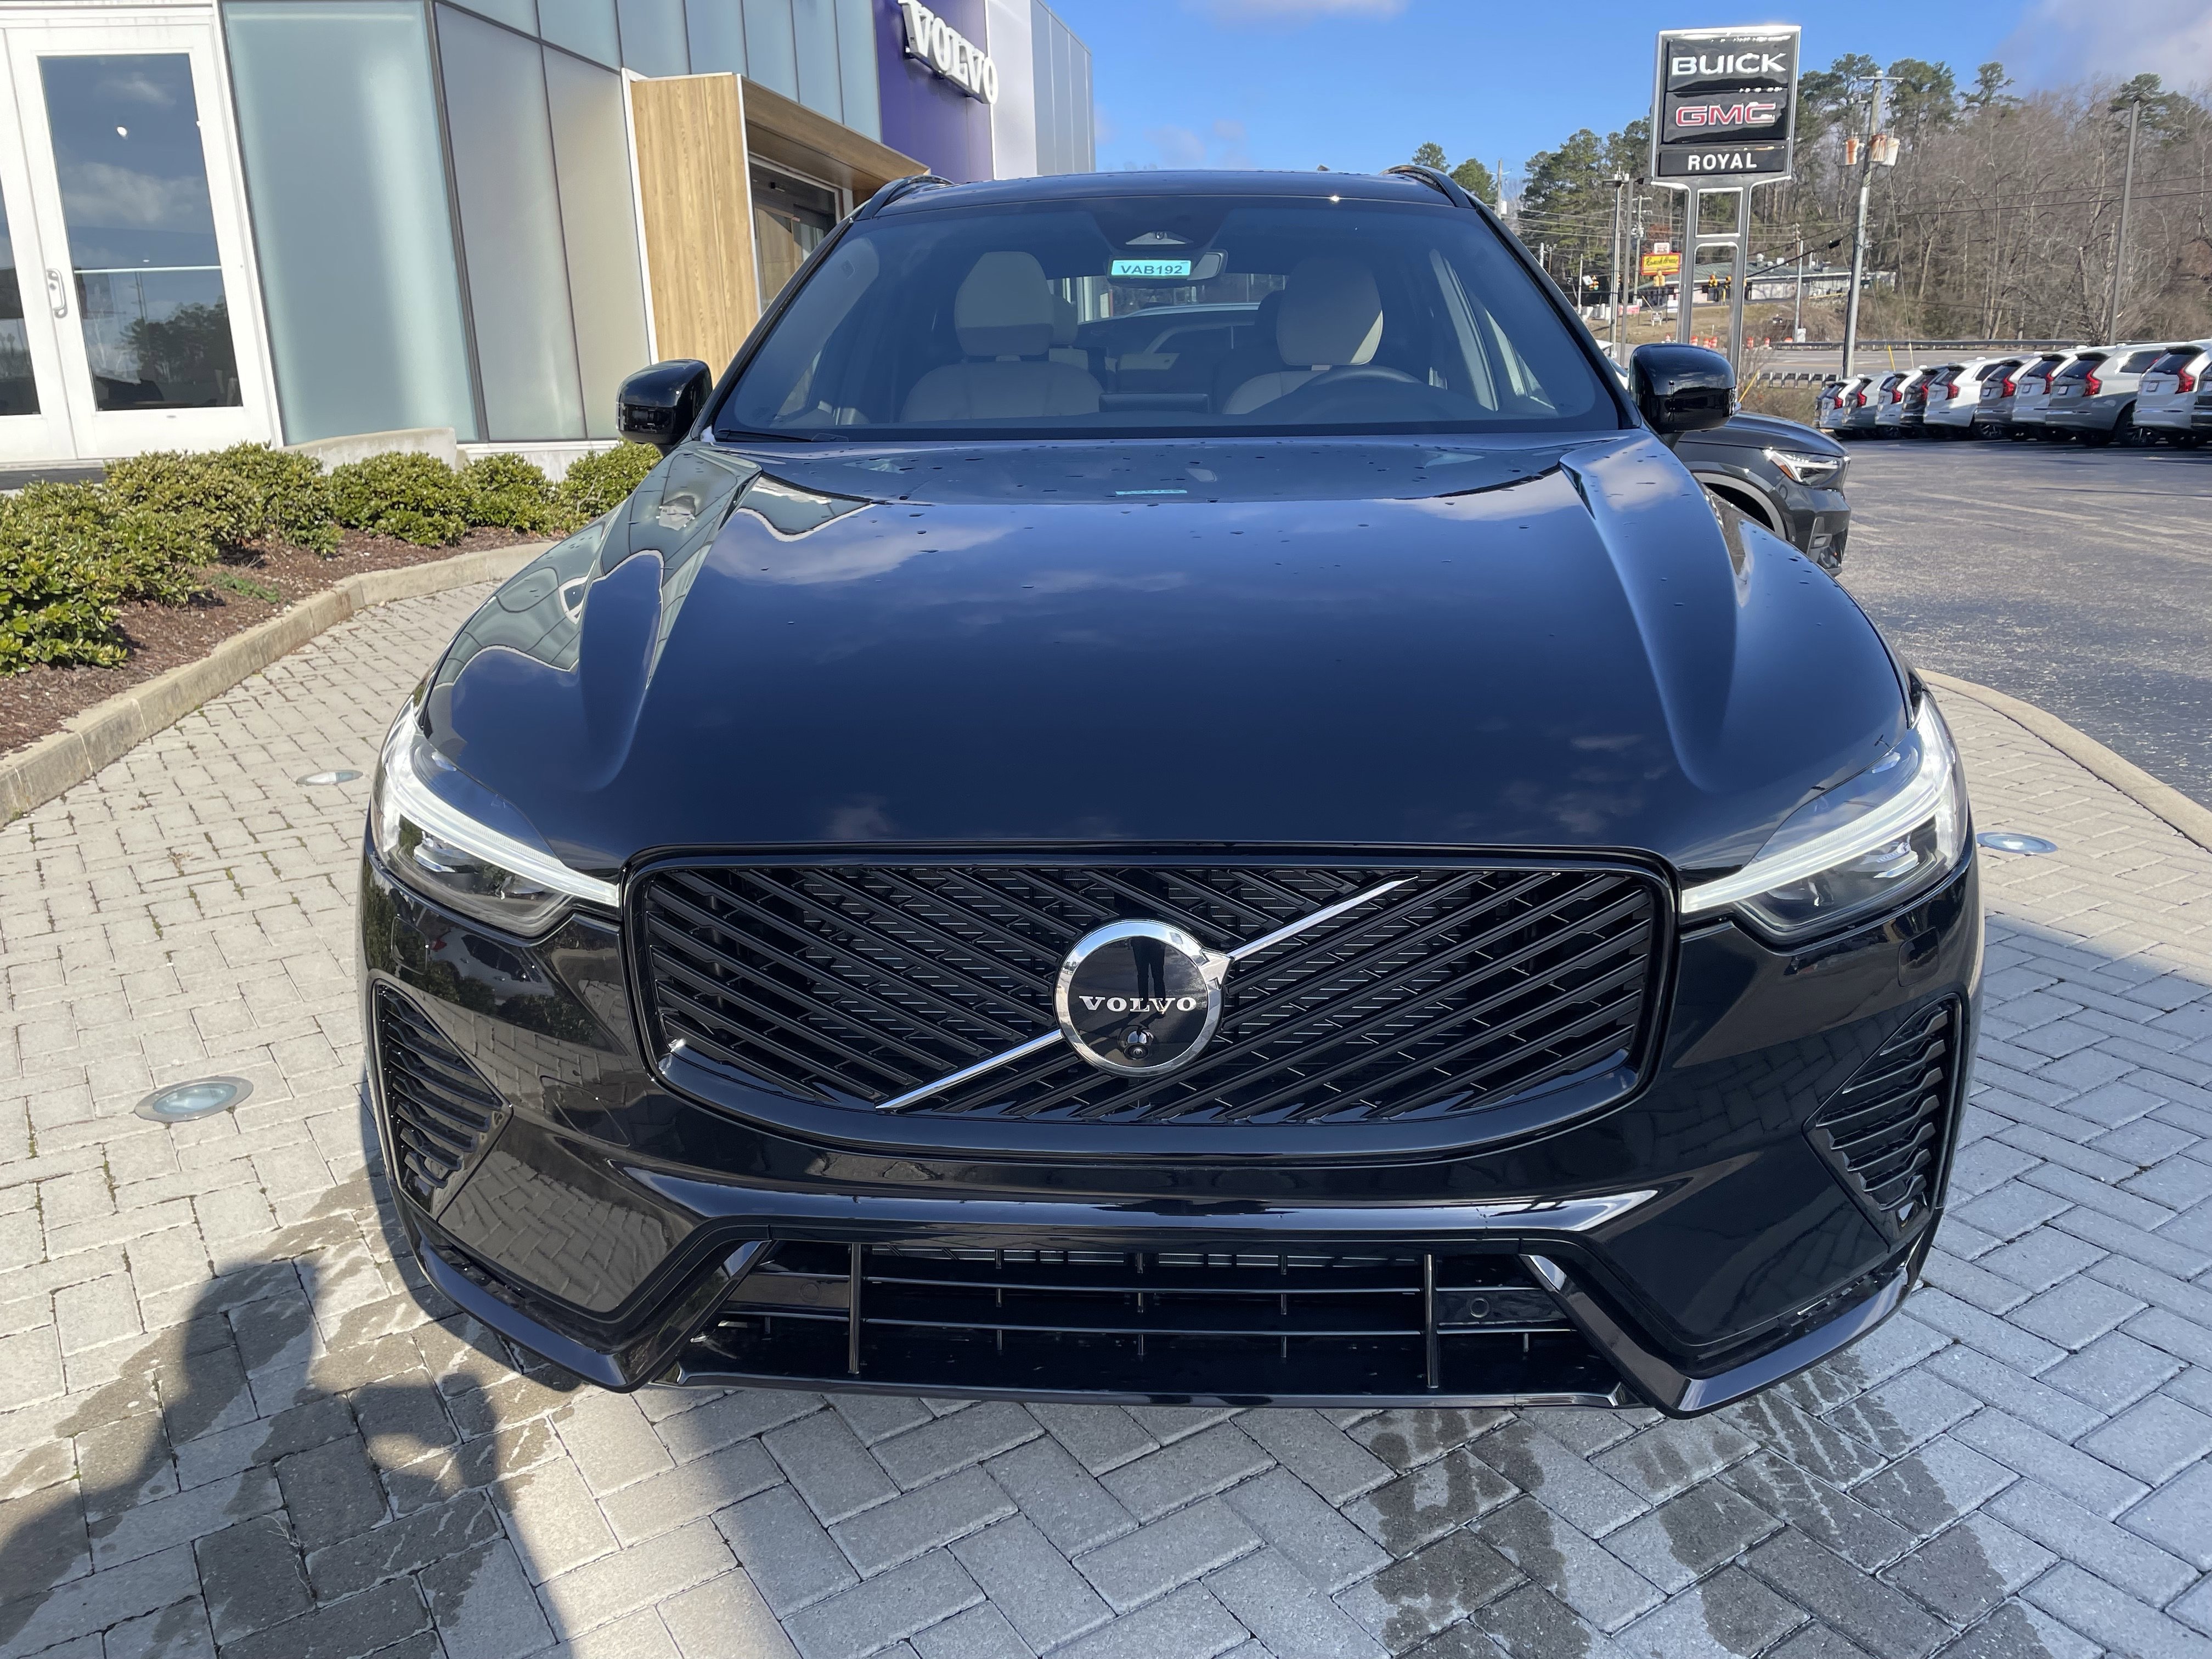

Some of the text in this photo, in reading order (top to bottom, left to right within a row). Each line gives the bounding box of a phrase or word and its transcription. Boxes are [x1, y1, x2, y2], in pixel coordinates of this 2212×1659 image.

[898, 0, 998, 105] VOLVO
[1671, 53, 1787, 76] BUICK
[1675, 101, 1776, 127] GMC
[1687, 153, 1757, 172] ROYAL
[1120, 265, 1183, 274] VAB192
[1079, 995, 1197, 1013] VOLVO
